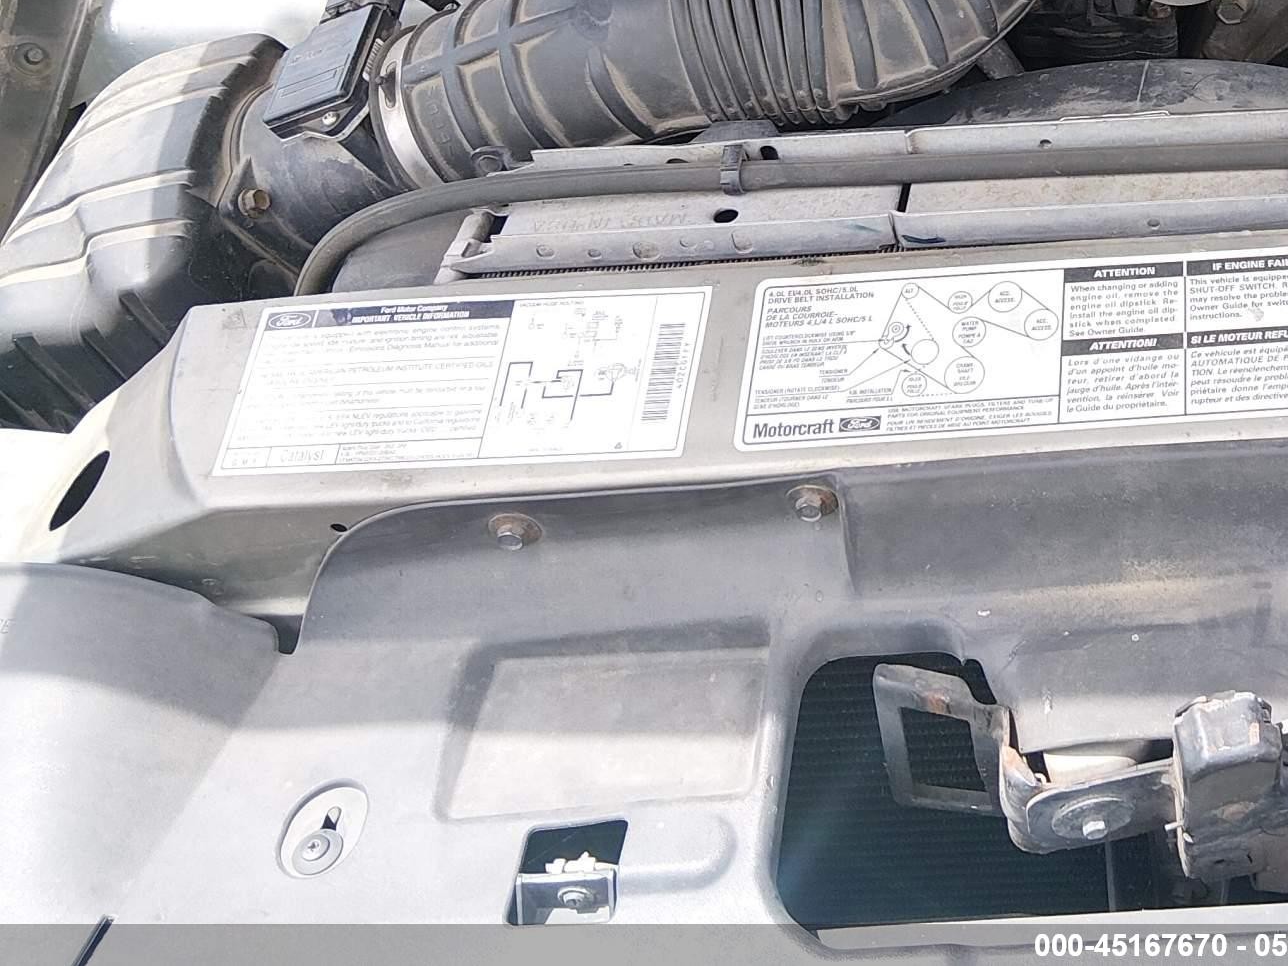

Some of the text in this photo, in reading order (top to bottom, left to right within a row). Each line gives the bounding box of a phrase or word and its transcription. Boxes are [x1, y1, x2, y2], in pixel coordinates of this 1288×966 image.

[1212, 262, 1222, 271] IF
[1224, 259, 1265, 270] ENGINE
[1093, 266, 1155, 277] ATTENTION
[1189, 277, 1207, 285] This
[1210, 276, 1239, 284] vehicle
[1242, 274, 1249, 282] is
[1070, 284, 1095, 292] When
[1096, 283, 1136, 292] changing
[1148, 280, 1178, 288] adding
[1189, 284, 1234, 294] SHUT-OFF
[767, 291, 874, 304] DRIVE BELT INSTALLATION
[1069, 294, 1102, 302] engine
[1162, 289, 1178, 298] the
[396, 305, 416, 313] Motor
[416, 304, 448, 313] Company
[766, 305, 812, 314] PARCOURS
[1069, 303, 1101, 311] engine
[1104, 300, 1116, 308] oil
[350, 310, 469, 322] IMPORTANT VEHICLE INFORMATION
[765, 312, 777, 321] DE
[778, 312, 789, 320] LA
[1069, 309, 1095, 319] install
[1115, 309, 1144, 317] engine
[1147, 306, 1158, 317] oil
[764, 319, 804, 328] MOTEURS
[1069, 320, 1091, 328] stick
[1068, 329, 1084, 337] See
[1086, 327, 1115, 335] Owner
[1190, 335, 1201, 344] SI
[1202, 333, 1216, 343] LE
[1217, 330, 1262, 342] MOTEUR
[1089, 338, 1157, 350] ATTENTION!
[752, 419, 833, 438] Motorcraft
